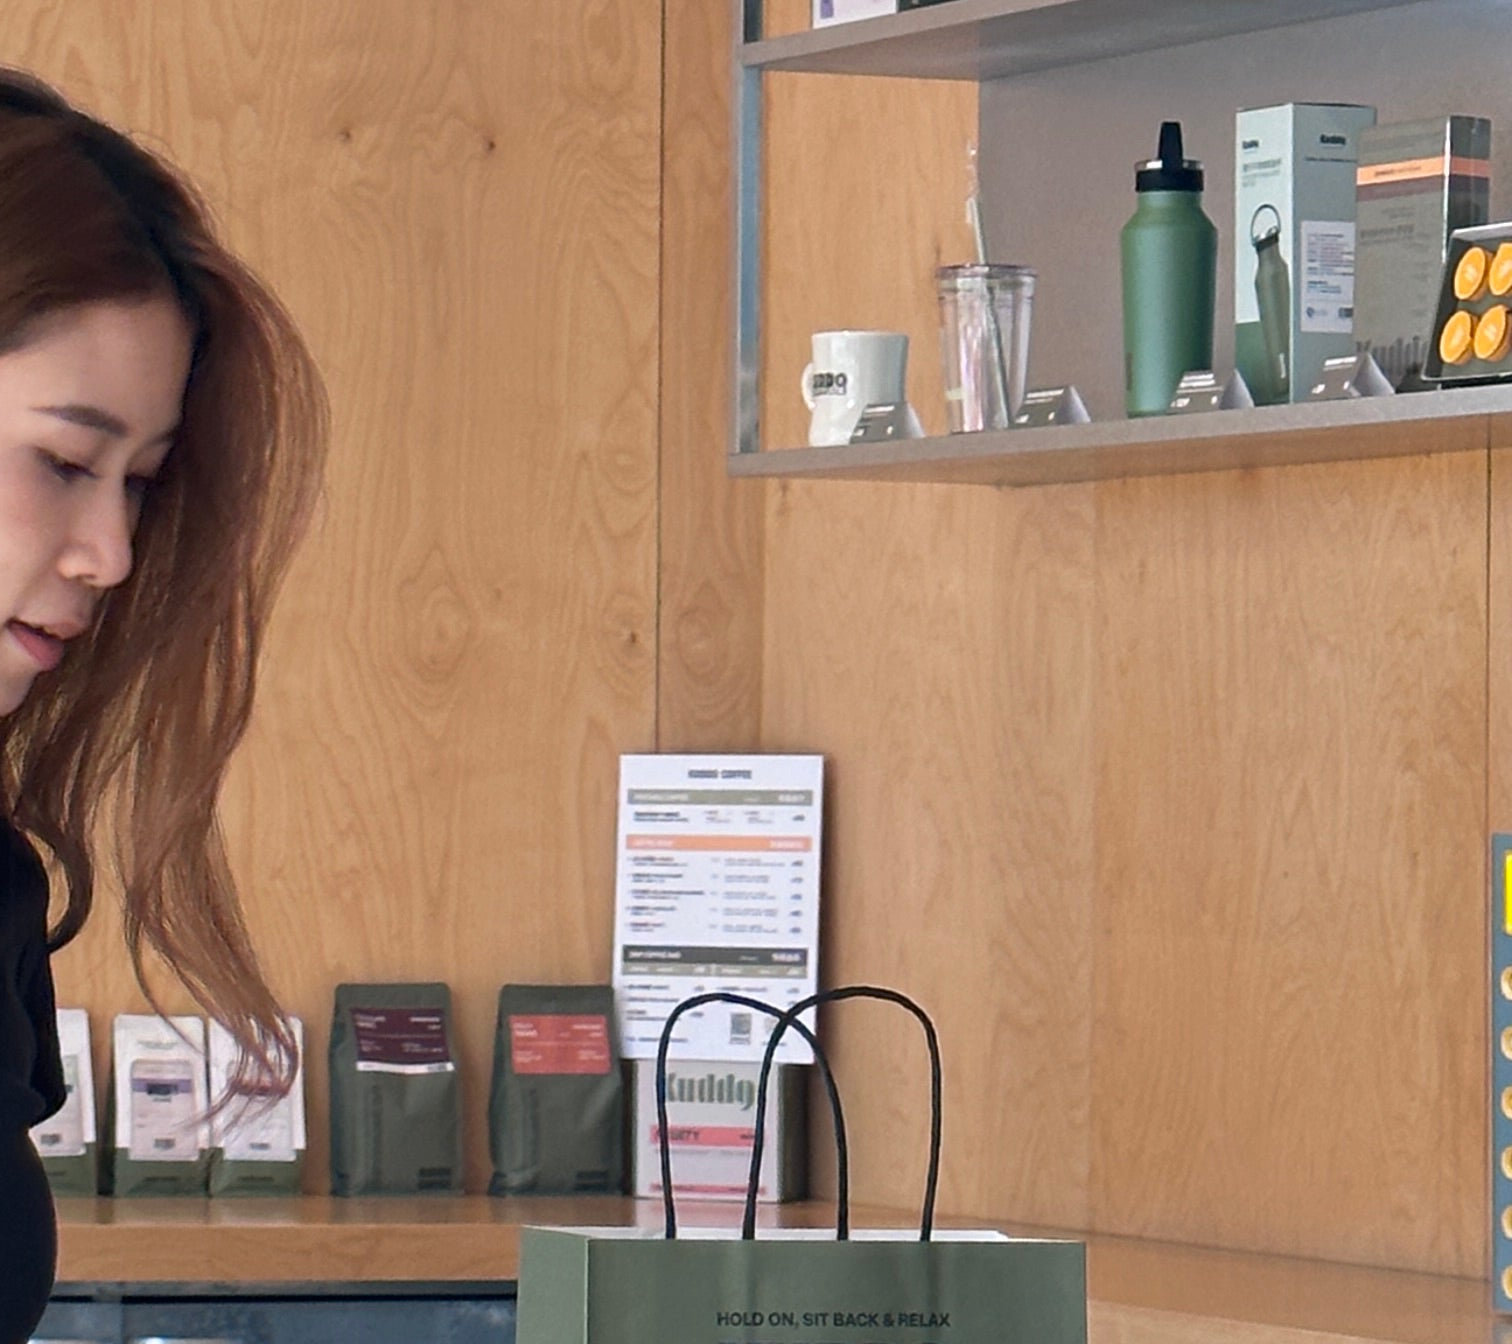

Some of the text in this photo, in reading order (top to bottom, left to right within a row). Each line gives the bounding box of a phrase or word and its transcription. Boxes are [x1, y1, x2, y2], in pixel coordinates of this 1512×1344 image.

[717, 1312, 951, 1329] HOLD ON, SIT BACK & RELAX
